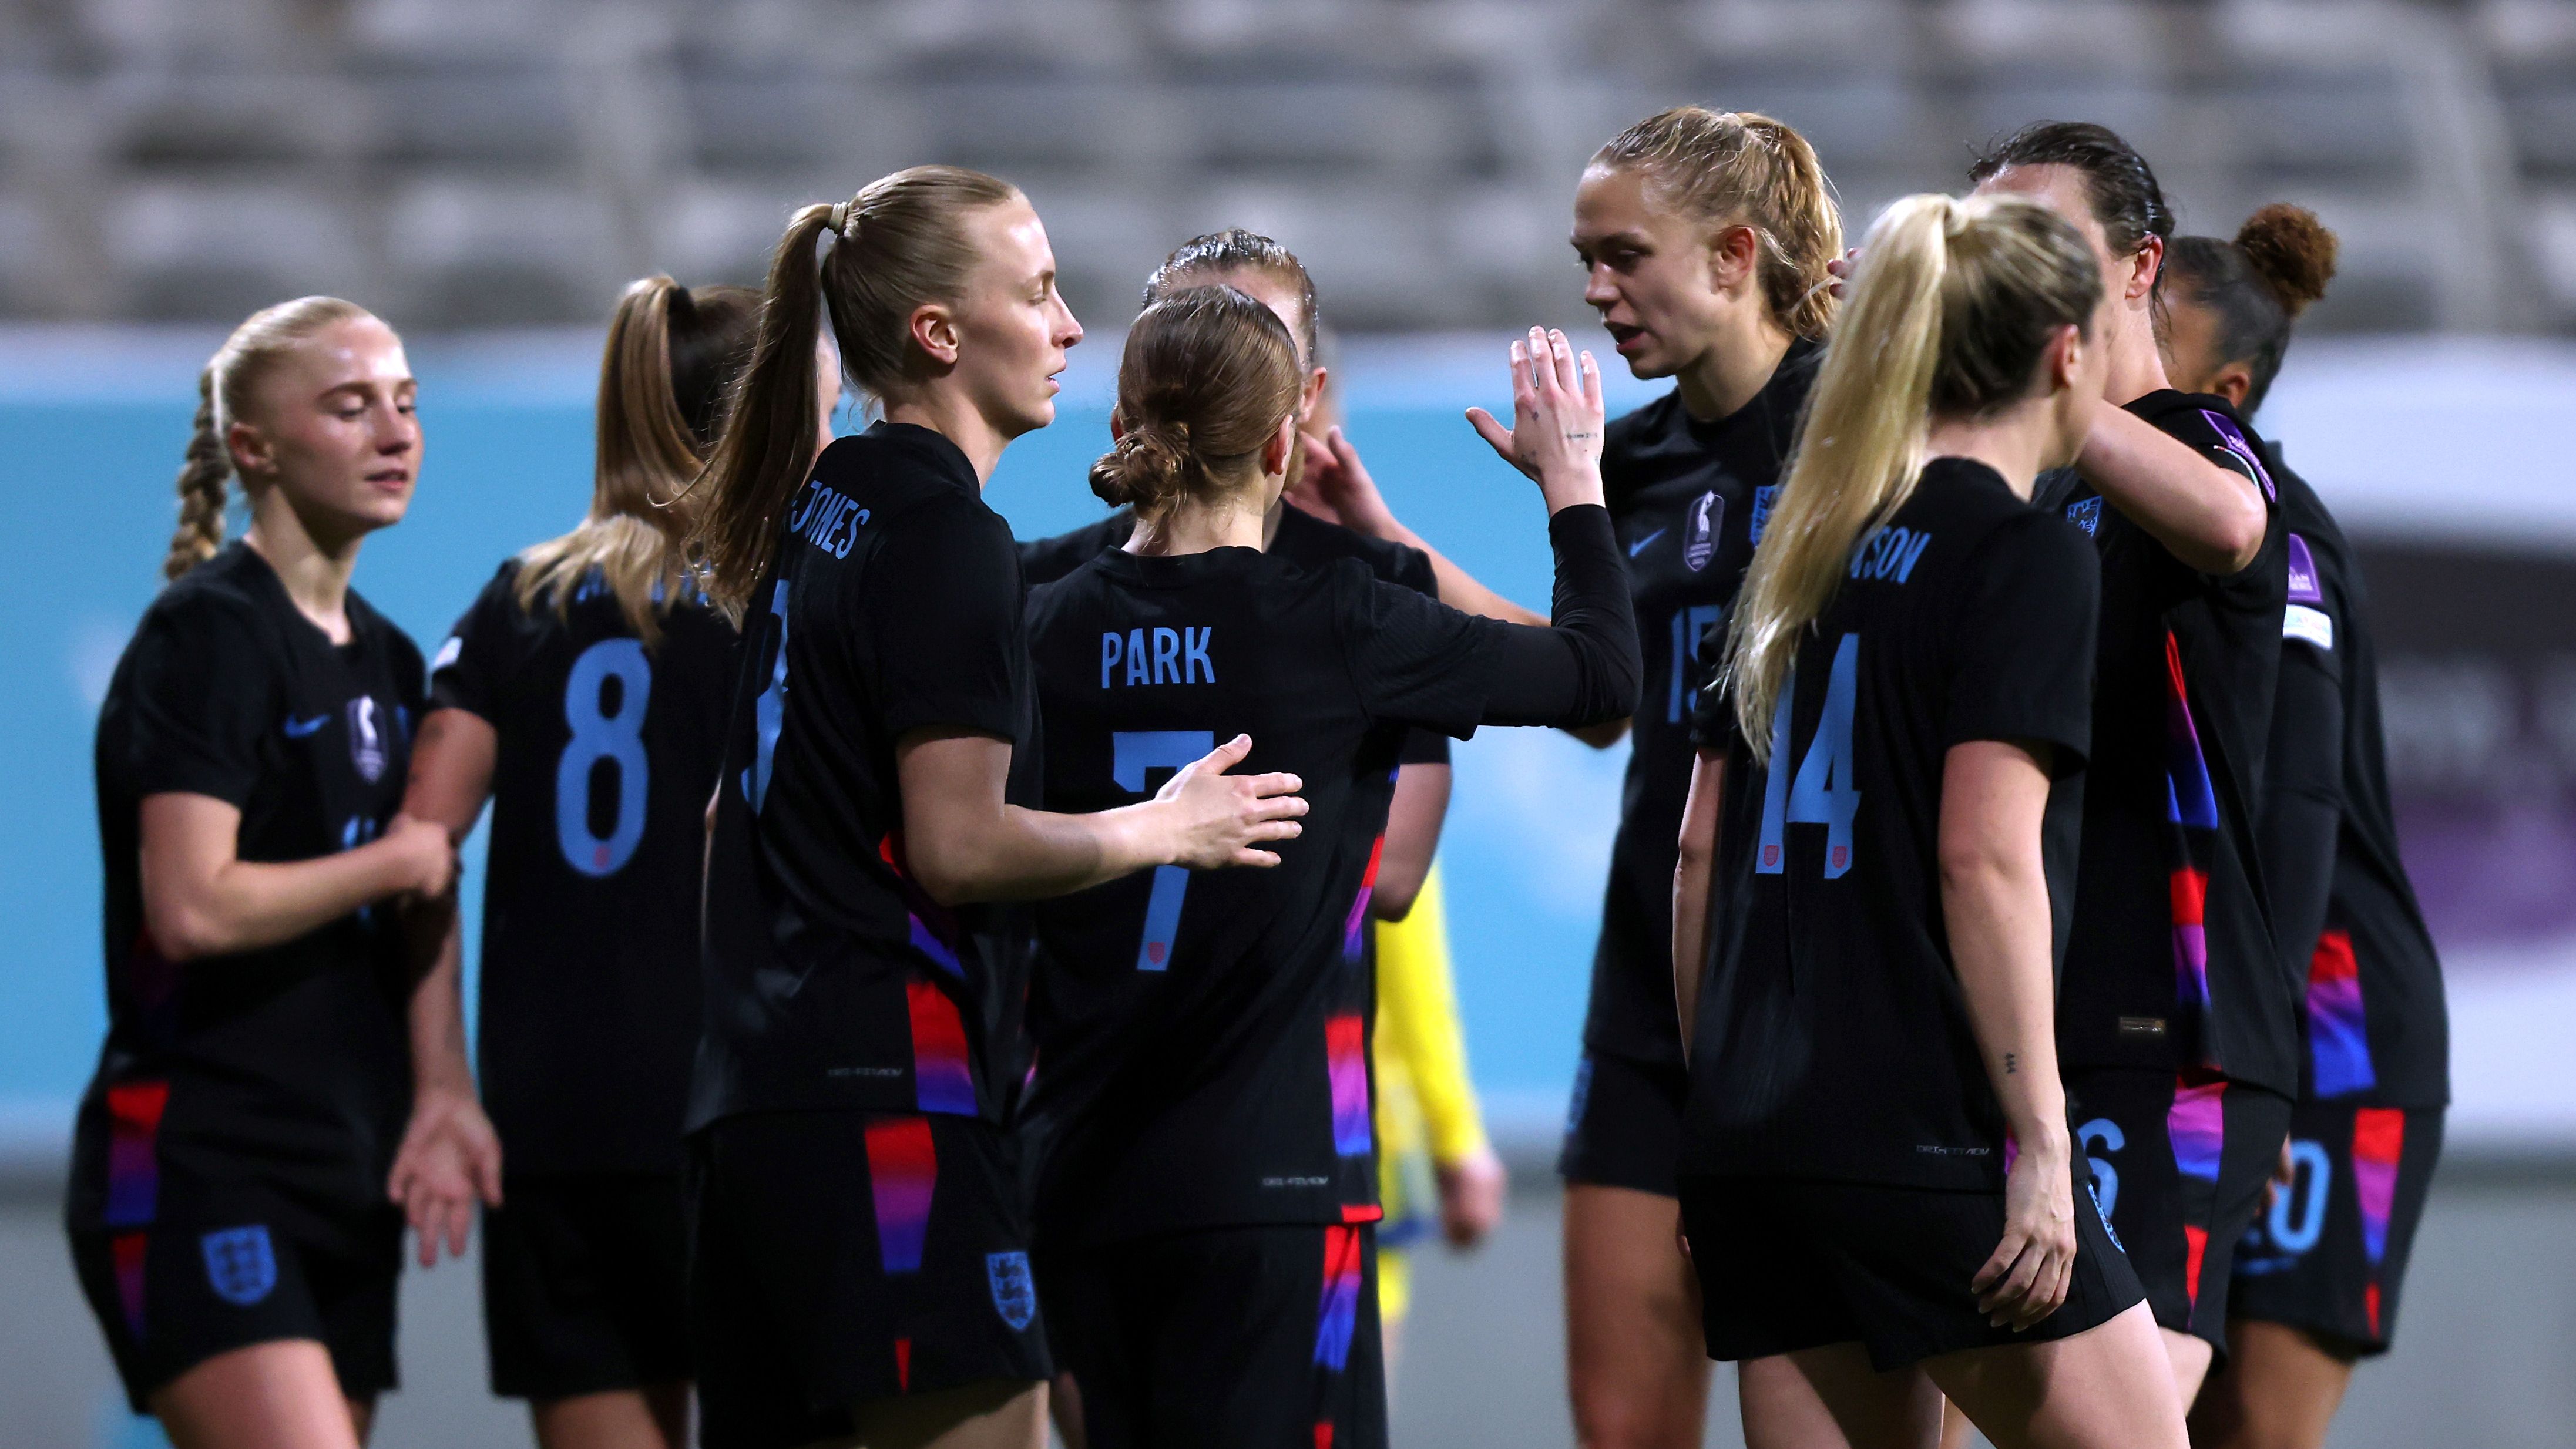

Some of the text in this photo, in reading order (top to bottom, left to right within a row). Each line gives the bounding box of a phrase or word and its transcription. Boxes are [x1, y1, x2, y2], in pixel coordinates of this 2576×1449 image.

[556, 637, 653, 878] 8
[1101, 626, 1217, 689] PARK
[1755, 632, 1862, 879] 14
[1113, 730, 1214, 972] 7
